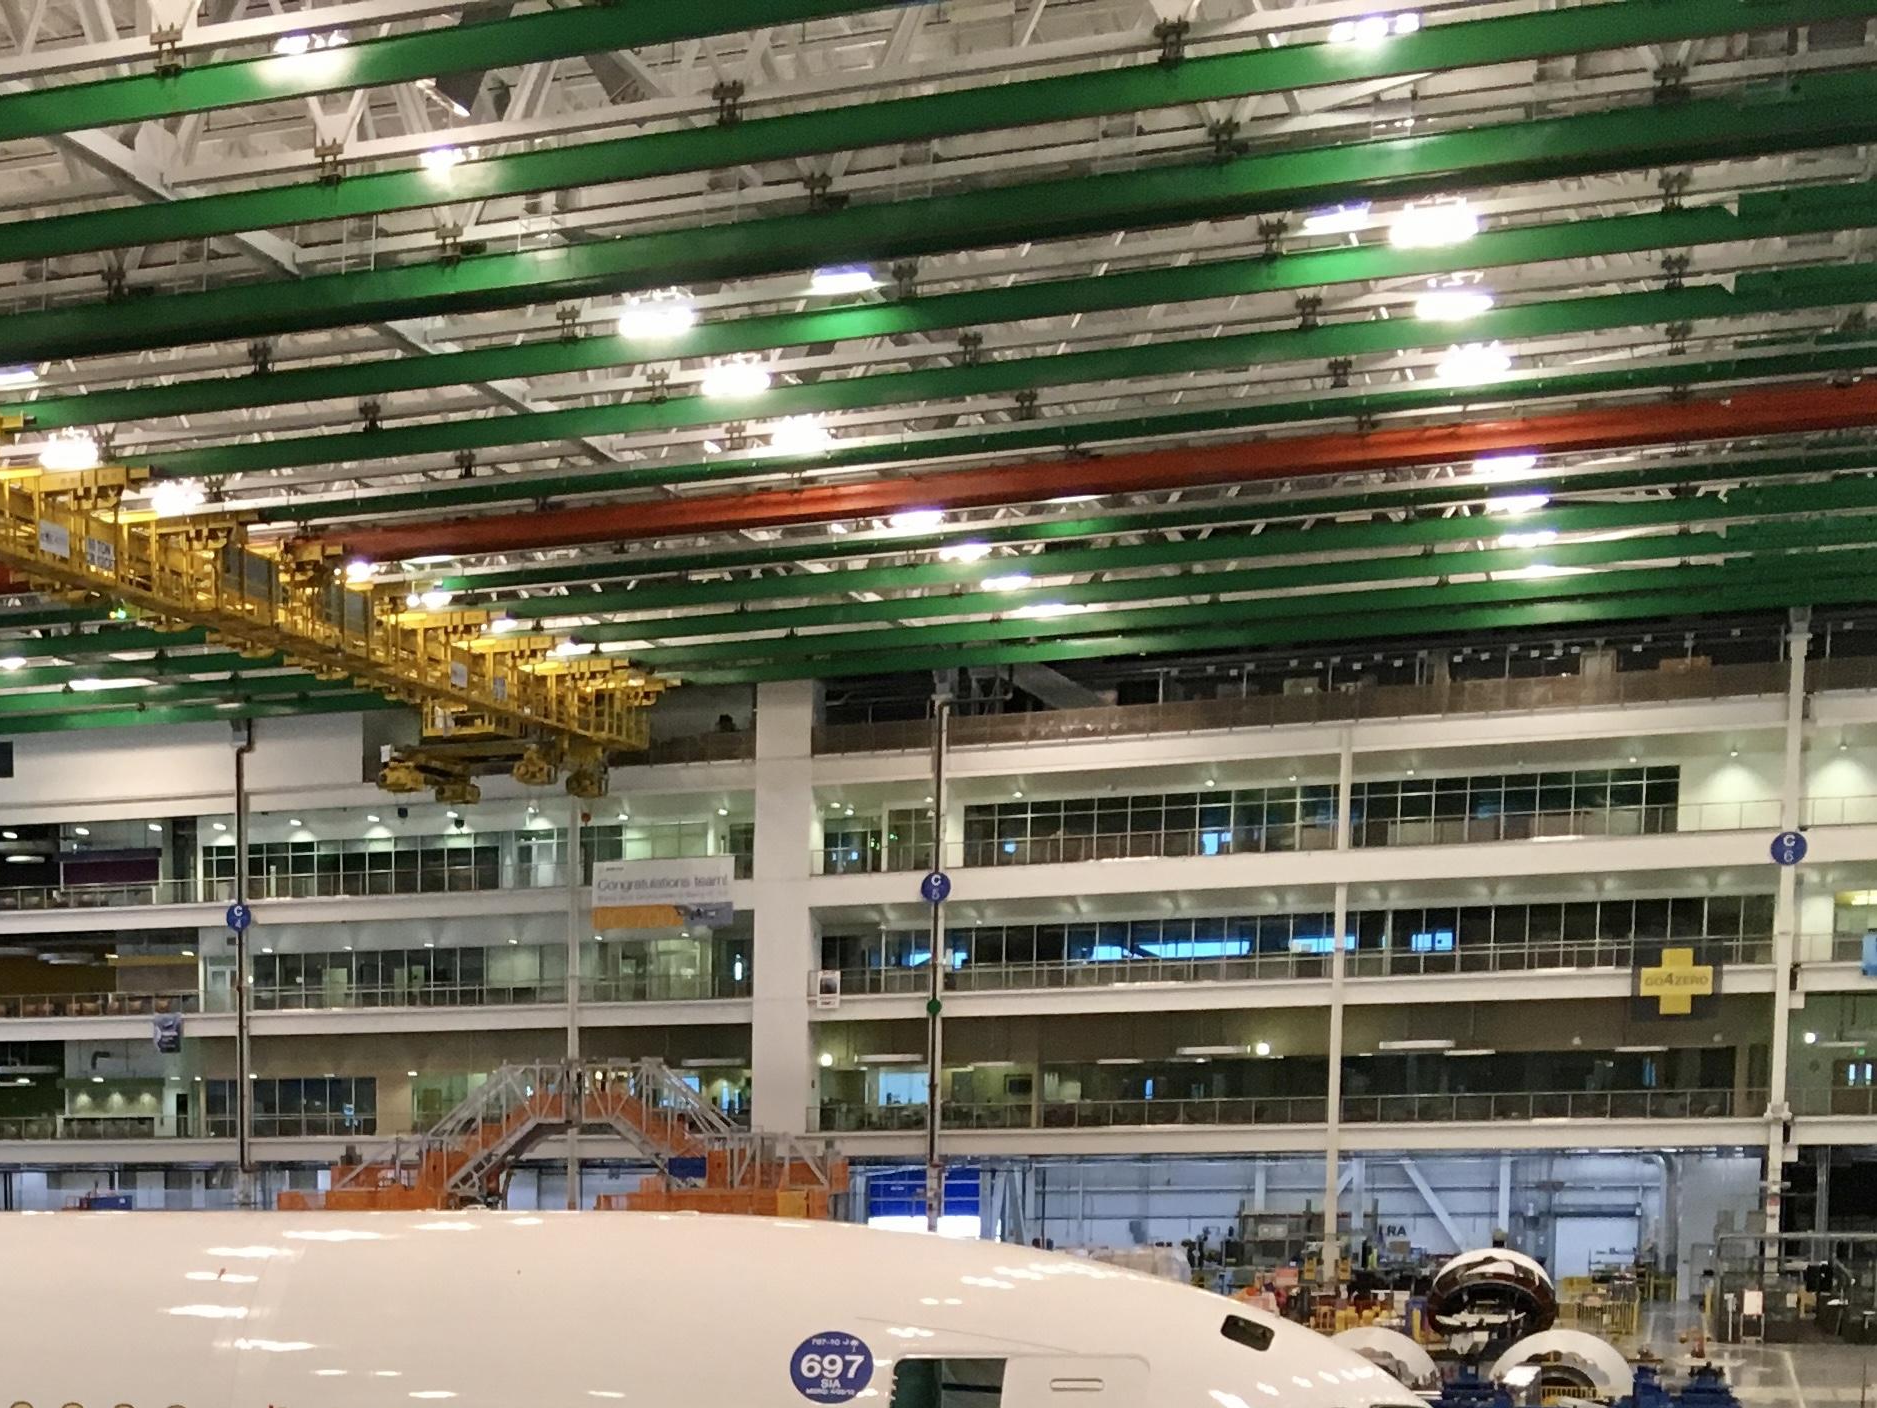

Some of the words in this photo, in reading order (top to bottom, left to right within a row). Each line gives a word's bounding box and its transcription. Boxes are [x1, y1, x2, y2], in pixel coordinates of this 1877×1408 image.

[1783, 834, 1796, 847] C
[1783, 850, 1794, 863] 6
[598, 876, 690, 893] Congratulations
[931, 874, 942, 886] C
[234, 905, 243, 917] C
[800, 1353, 865, 1379] 697
[820, 1379, 841, 1389] SIA
